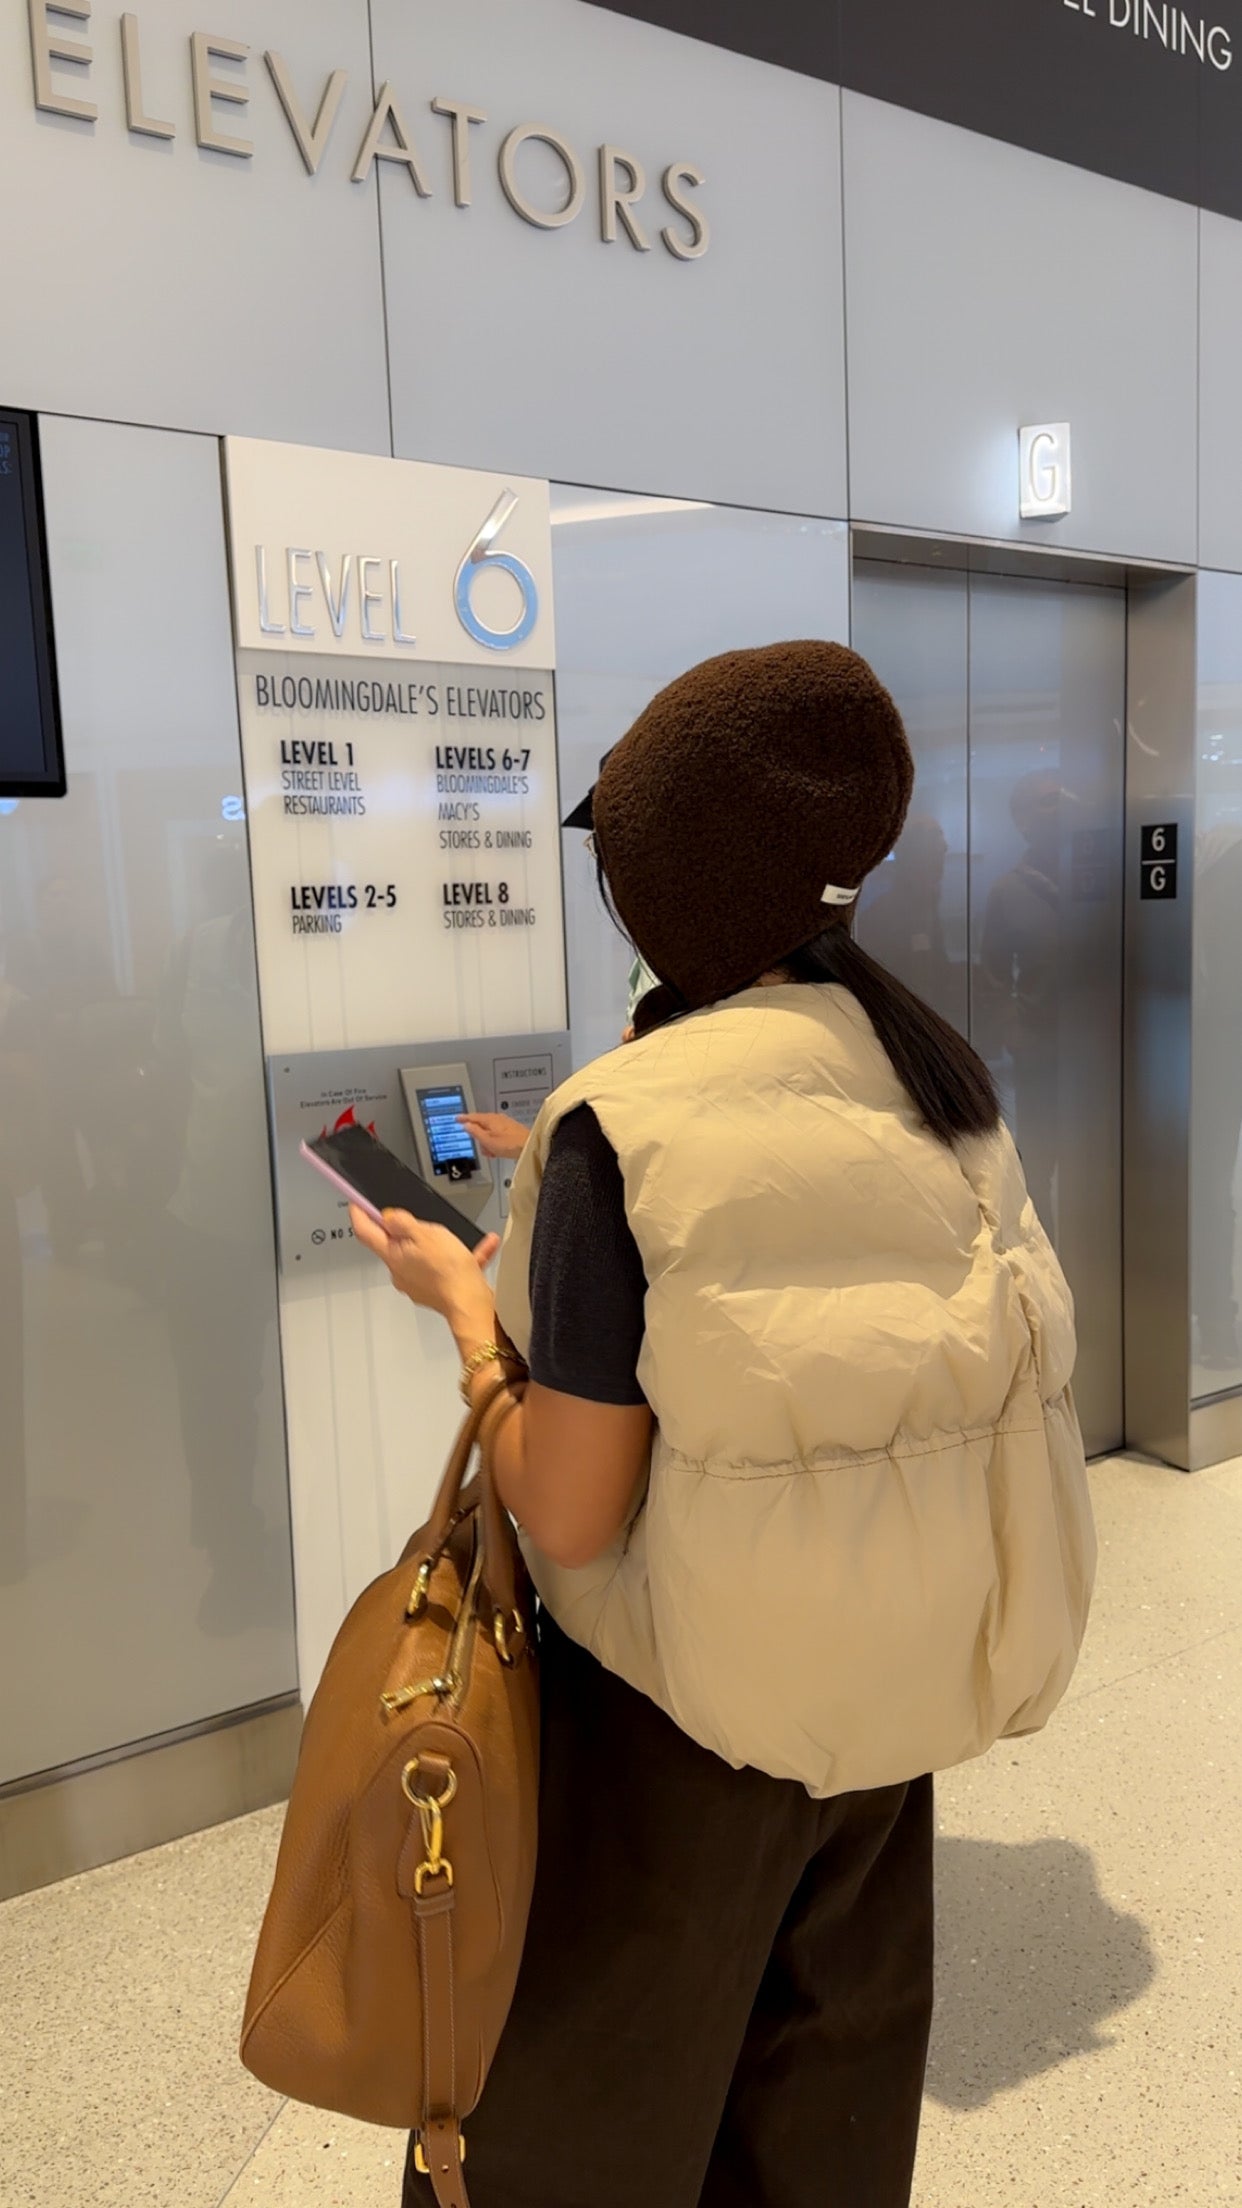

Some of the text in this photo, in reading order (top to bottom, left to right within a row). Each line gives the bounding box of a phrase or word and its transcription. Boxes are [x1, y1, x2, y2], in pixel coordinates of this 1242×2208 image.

[1109, 0, 1233, 71] DINING
[28, 0, 711, 261] ELEVATORS
[1028, 432, 1058, 502] G
[255, 486, 540, 651] LEVEL 6
[255, 674, 546, 720] BLOOMINGDALE'S ELEVATORS
[280, 740, 354, 766] LEVEL 1
[435, 745, 531, 772] LEVELS 6-7
[281, 770, 362, 792] STREET LEVEL
[436, 774, 530, 794] BLOOMINGDALE'S
[283, 795, 367, 816] RESTAURANTS
[438, 802, 481, 821] MACY'S
[439, 830, 532, 849] STORES & DINING
[1151, 827, 1166, 852] 6
[1149, 866, 1167, 892] G
[290, 884, 397, 910] LEVELS 2-5
[443, 882, 509, 905] LEVEL 8
[292, 914, 343, 935] PARKING
[443, 908, 536, 929] STORES & DINING
